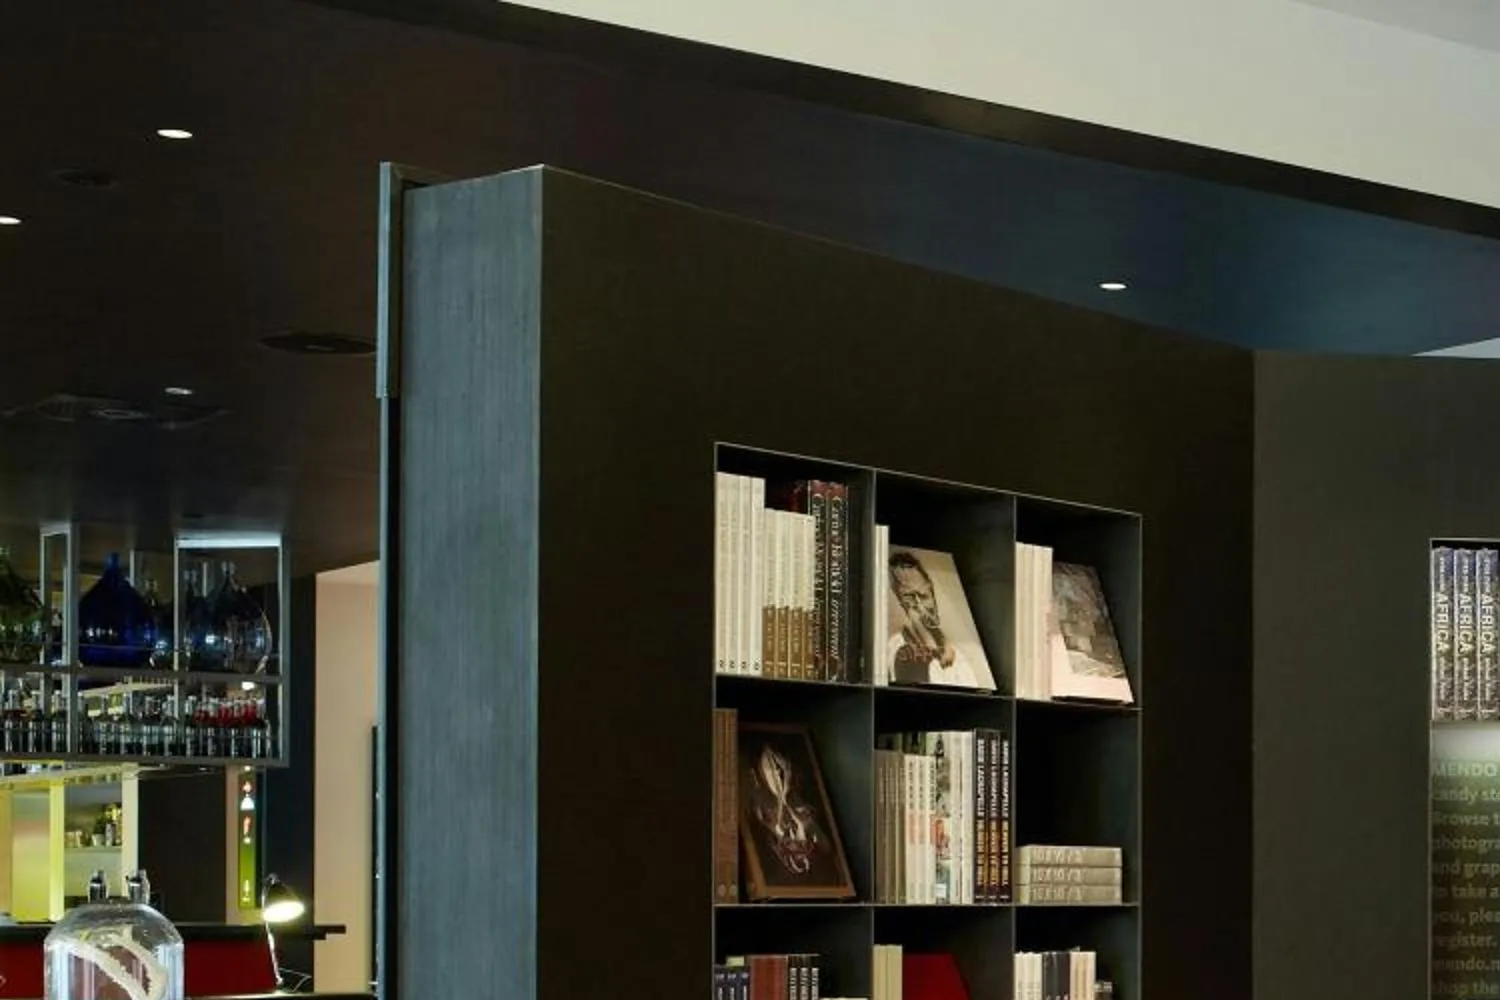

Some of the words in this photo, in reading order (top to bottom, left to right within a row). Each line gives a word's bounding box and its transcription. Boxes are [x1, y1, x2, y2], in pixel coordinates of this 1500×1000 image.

[1432, 763, 1498, 778] MENDO
[1451, 882, 1487, 899] take
[1433, 978, 1470, 998] hop
[1472, 977, 1500, 995] the
